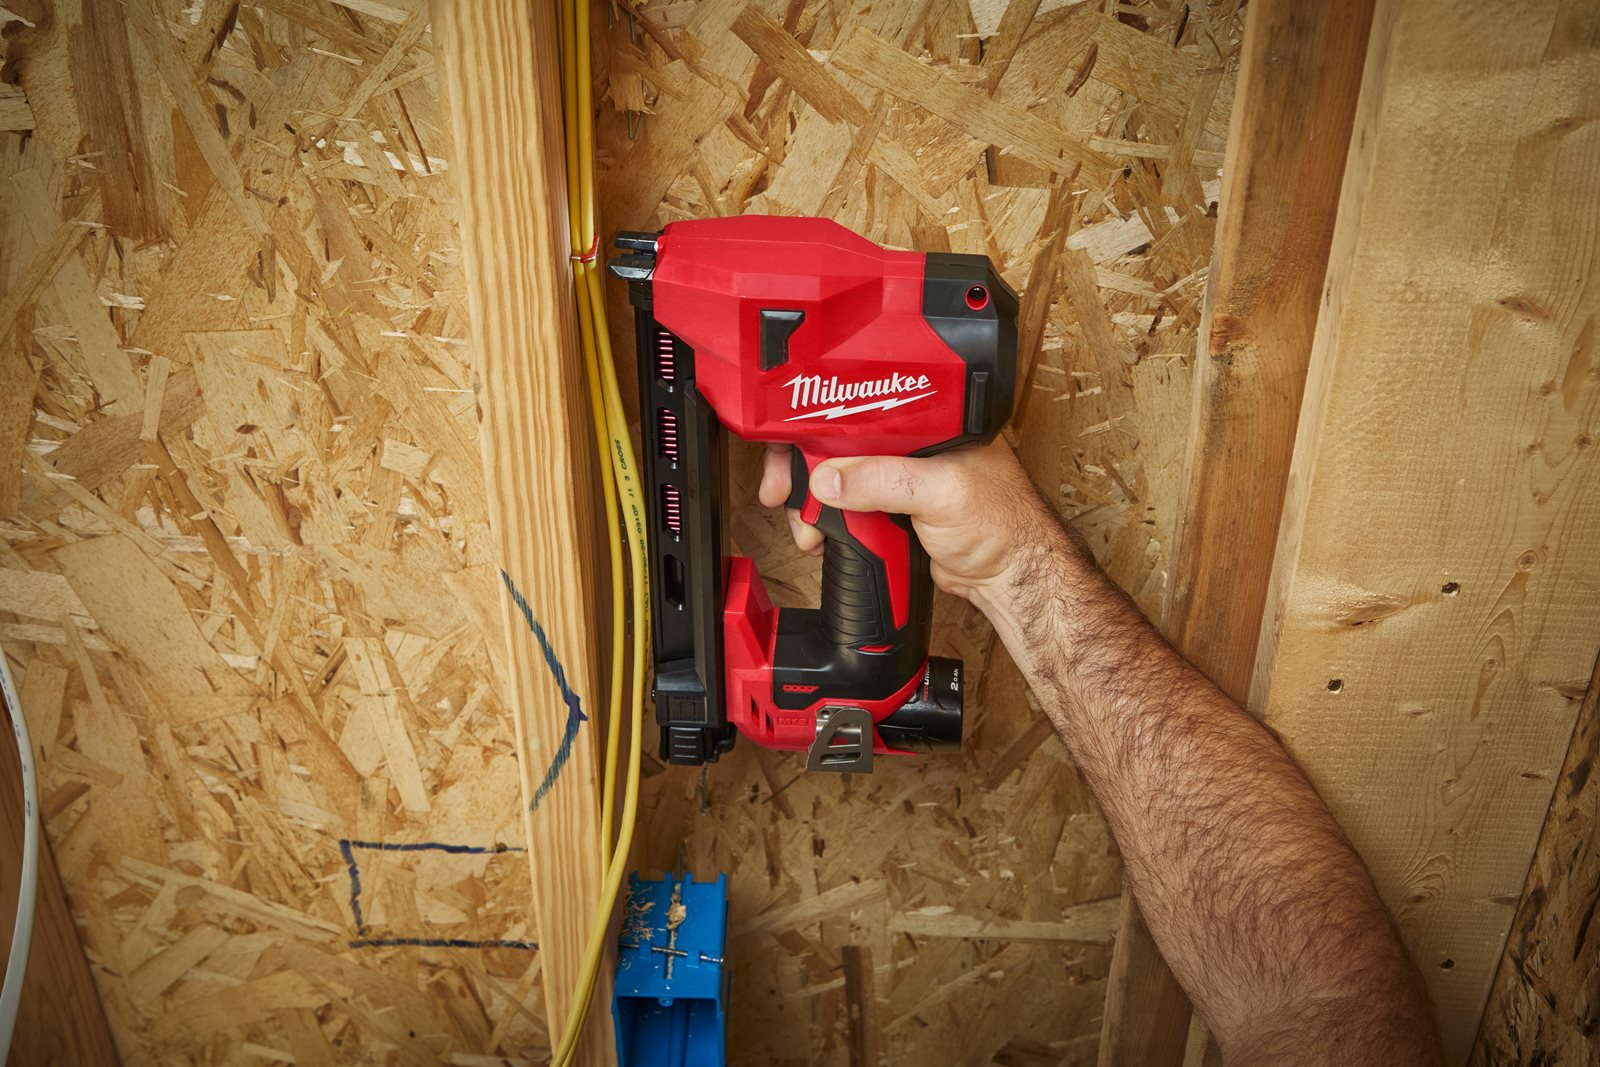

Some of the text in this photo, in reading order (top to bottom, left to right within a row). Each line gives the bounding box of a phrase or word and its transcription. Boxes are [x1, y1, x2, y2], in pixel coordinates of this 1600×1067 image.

[781, 372, 931, 410] Milwaukee
[615, 439, 626, 470] CROSS
[953, 668, 959, 677] Ah
